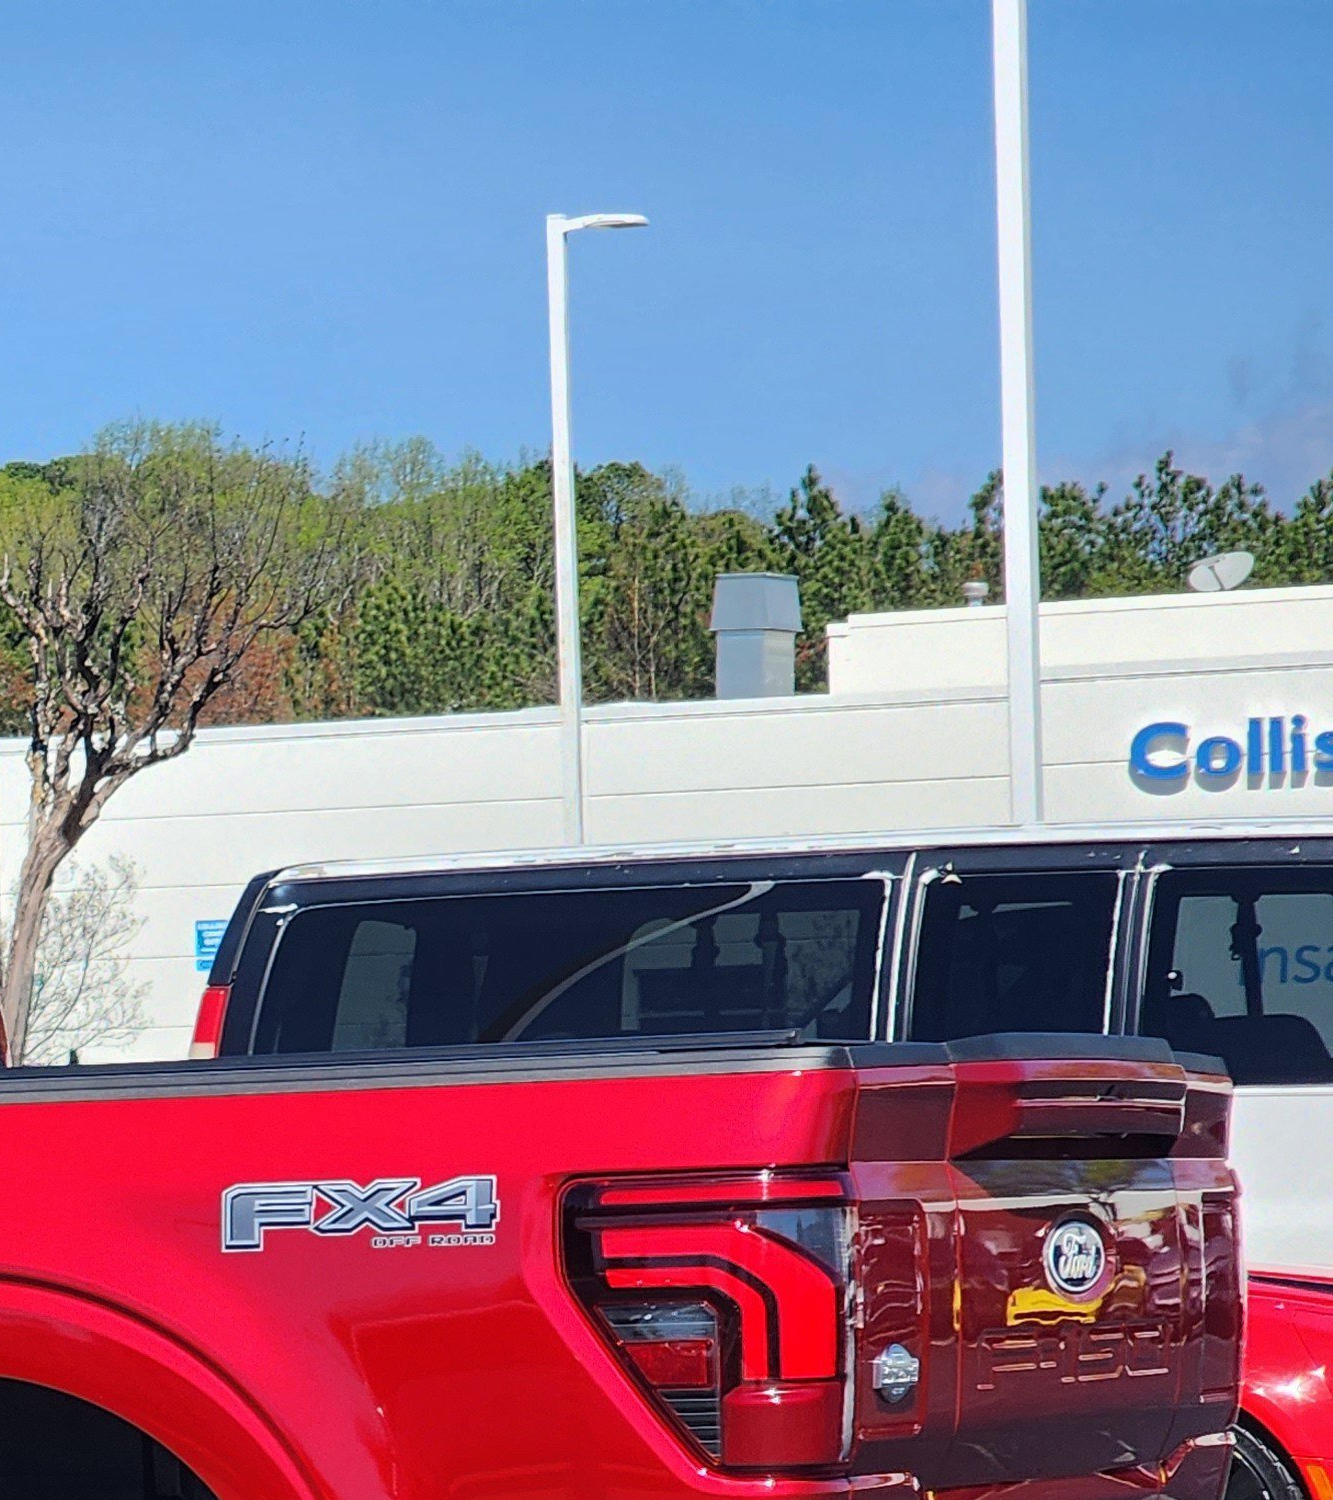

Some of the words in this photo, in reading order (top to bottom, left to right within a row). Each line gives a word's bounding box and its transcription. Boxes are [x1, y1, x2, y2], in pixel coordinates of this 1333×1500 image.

[221, 1175, 501, 1252] FX4
[371, 1235, 422, 1248] OFF
[427, 1234, 496, 1247] ROAD
[1058, 1233, 1098, 1280] Ford
